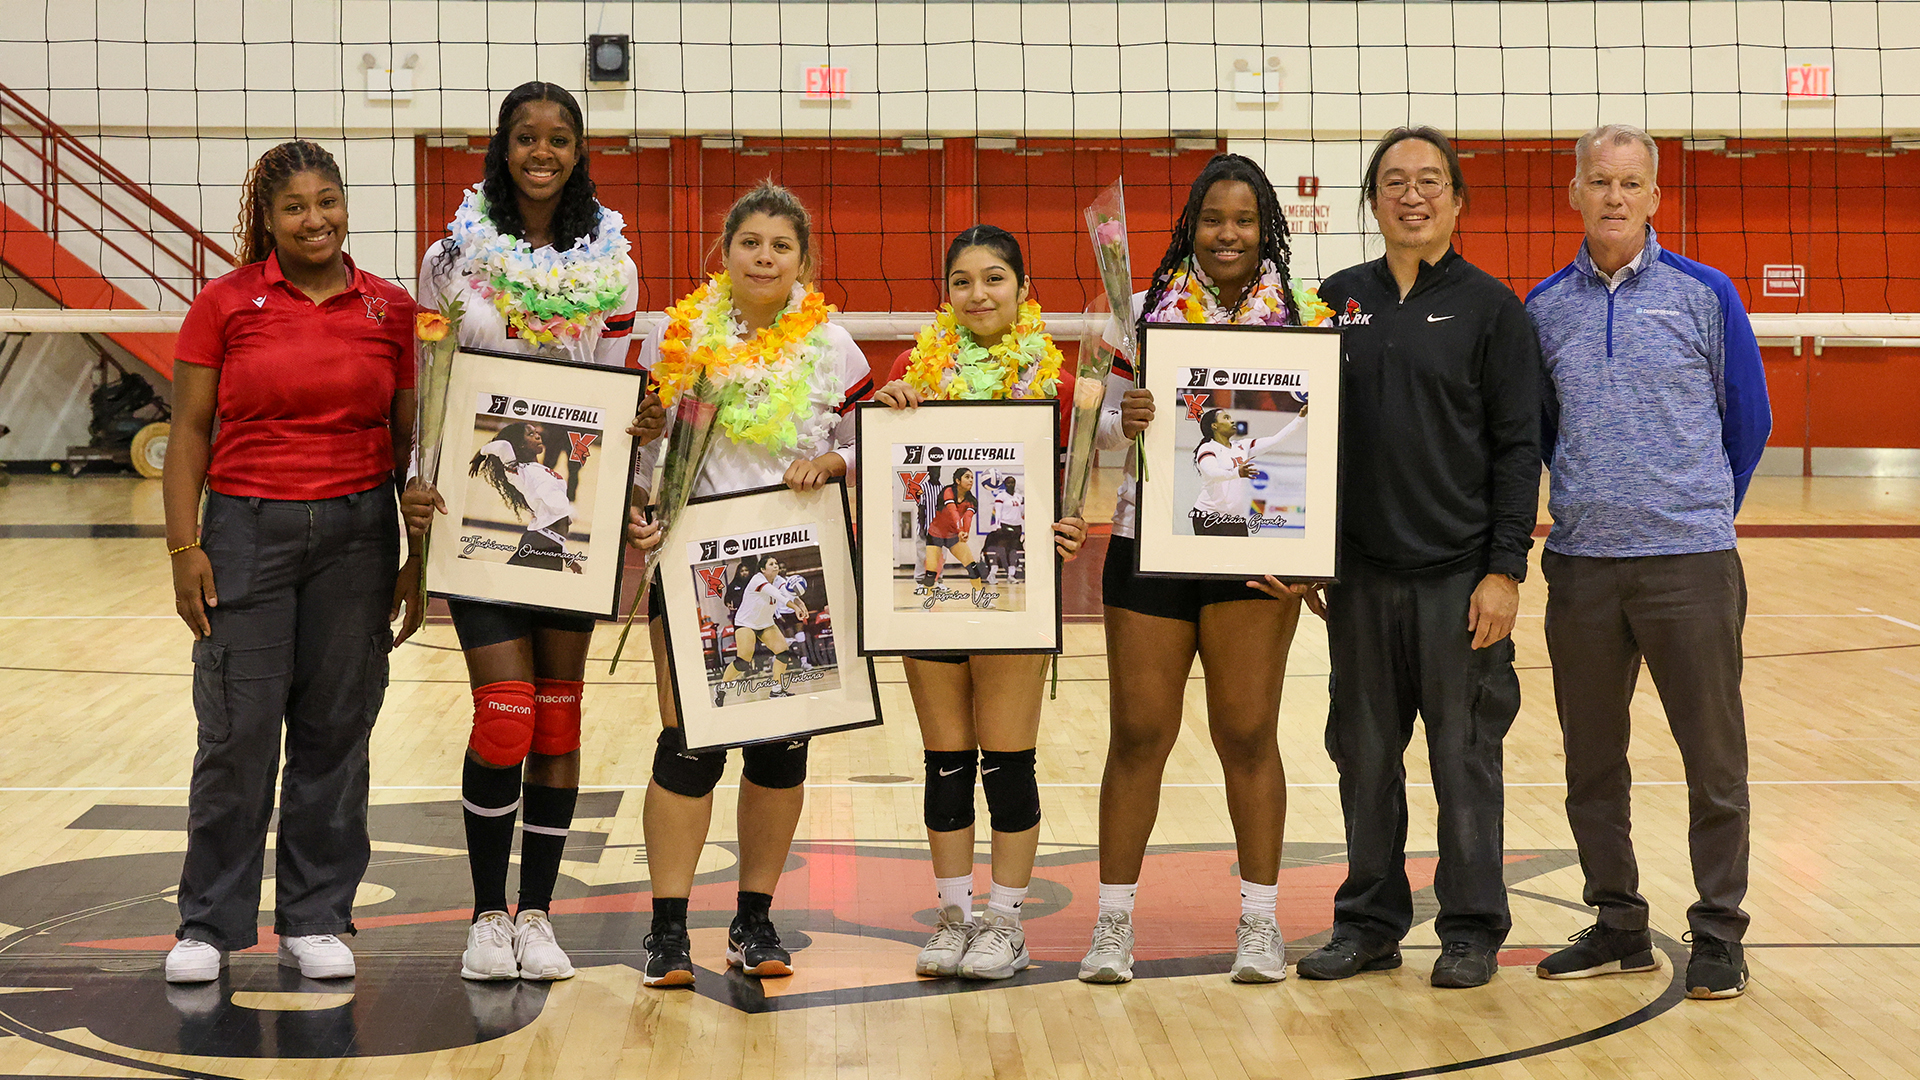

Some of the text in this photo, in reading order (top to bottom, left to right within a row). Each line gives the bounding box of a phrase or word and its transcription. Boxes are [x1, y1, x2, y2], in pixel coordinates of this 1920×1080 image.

[805, 67, 849, 98] EXIT
[1787, 67, 1831, 98] EXIT
[1284, 205, 1330, 218] EMERGENCY
[1309, 221, 1329, 232] ONLY
[1338, 313, 1373, 327] YORK
[1232, 372, 1301, 386] VOLLEYBALL
[531, 404, 598, 424] VOLLEYBALL
[947, 448, 1016, 460] VOLLEYBALL
[742, 530, 810, 551] VOLLEYBALL
[923, 588, 970, 609] Jasmine
[972, 587, 999, 608] Vega
[720, 681, 737, 690] #17
[535, 695, 575, 703] macron
[488, 701, 531, 714] macron
